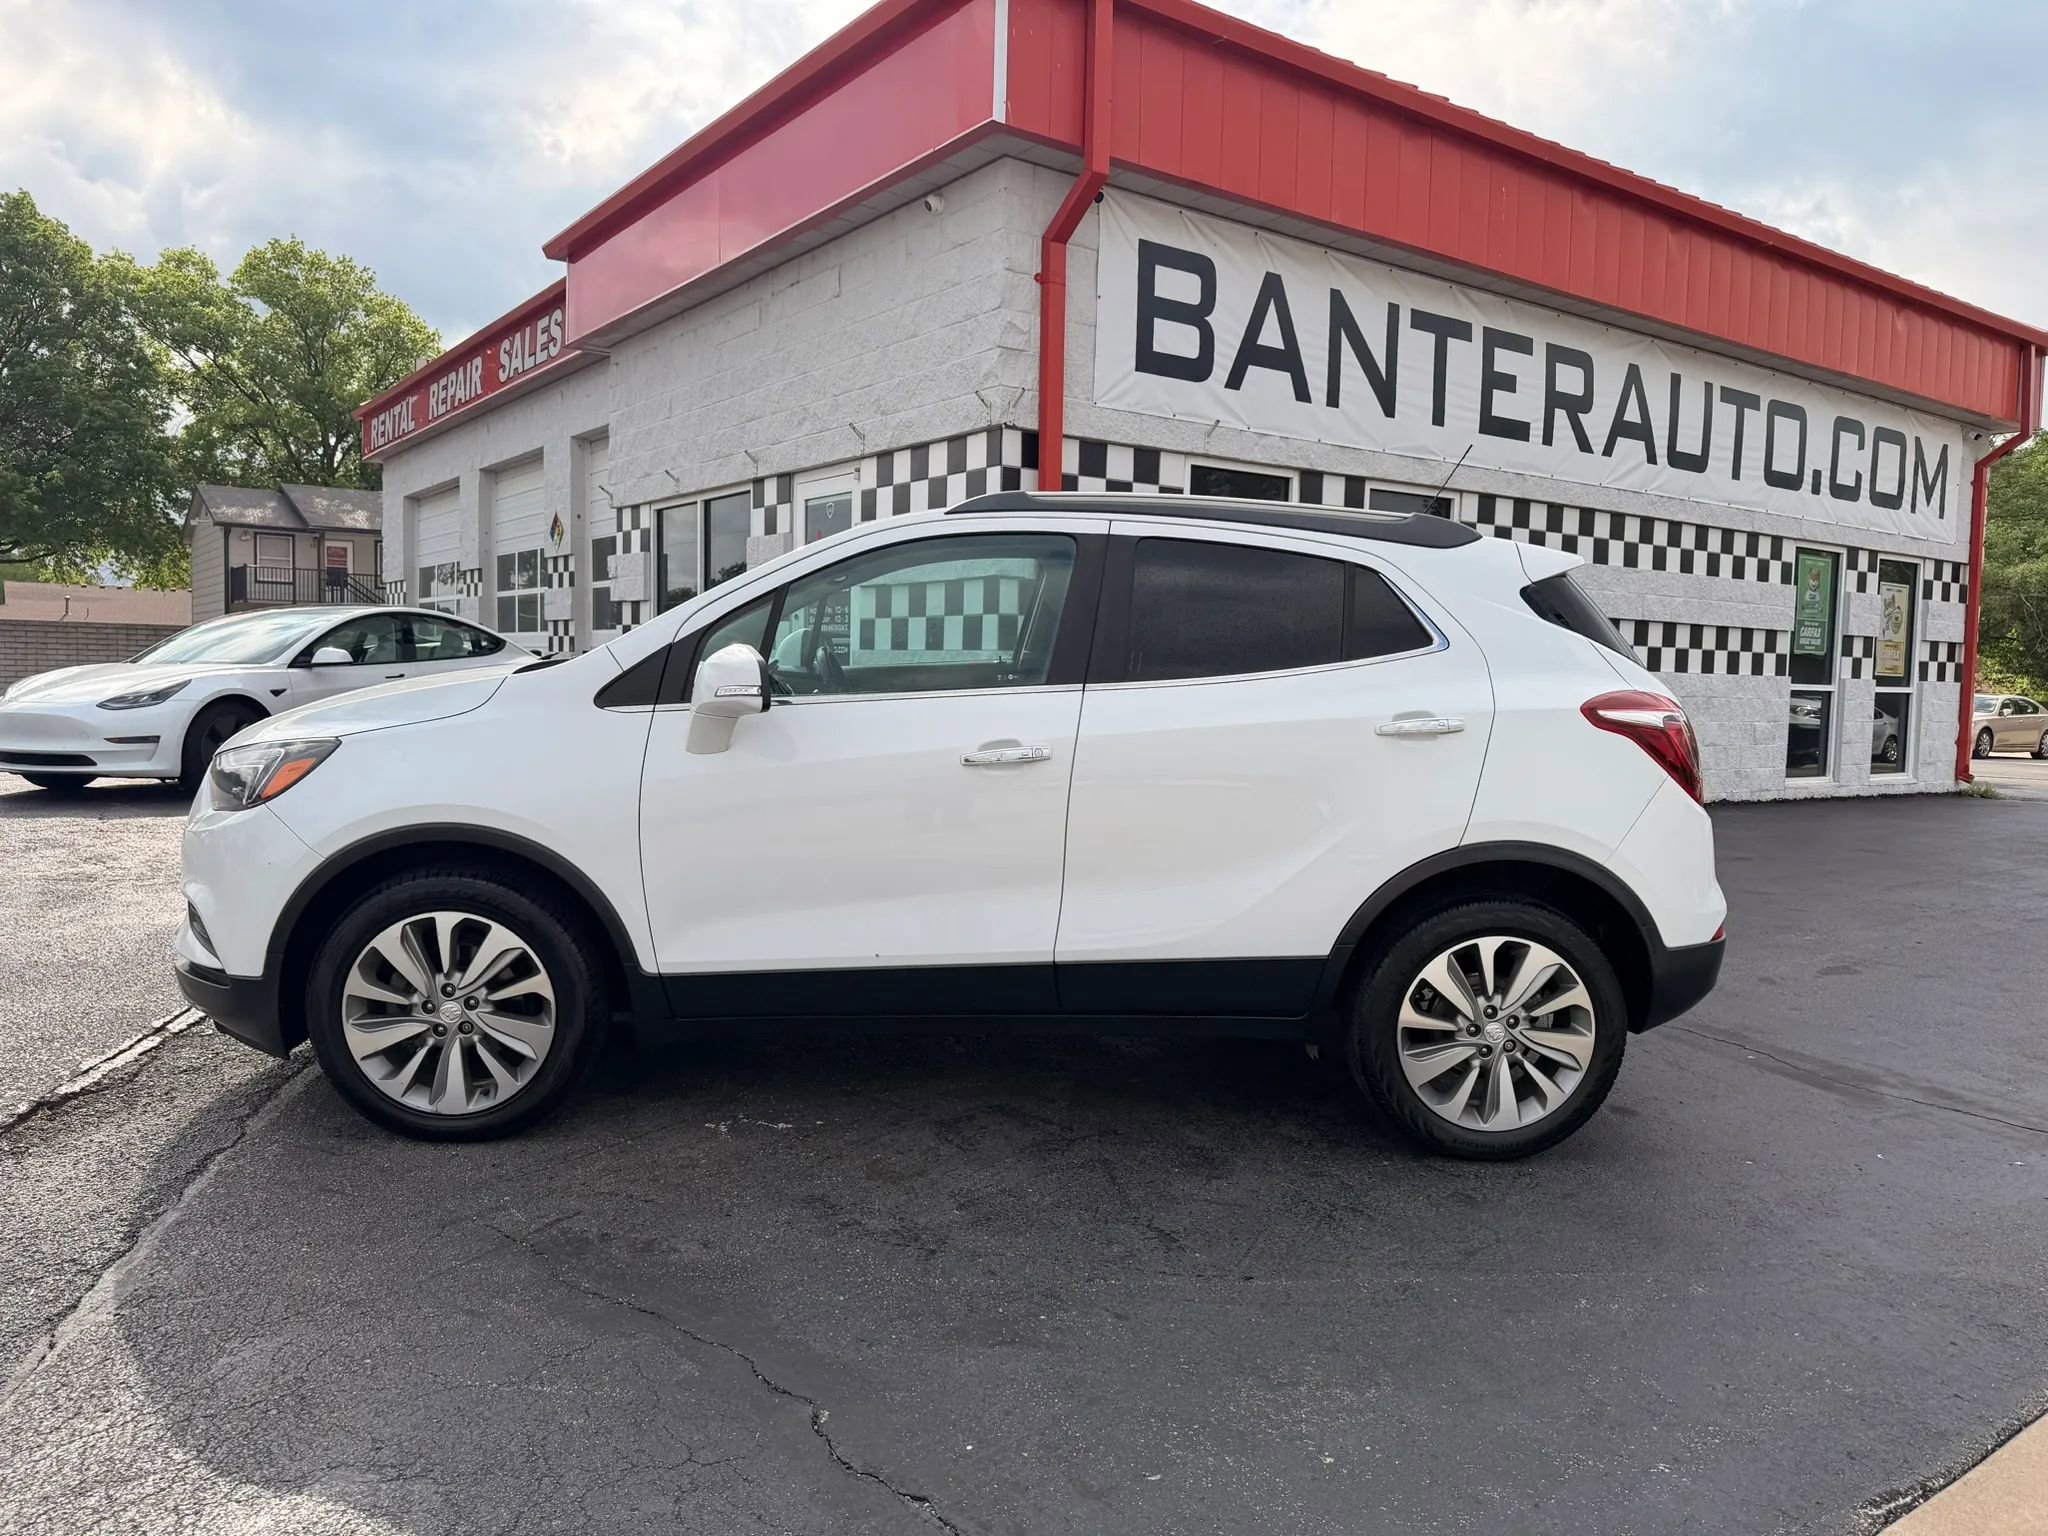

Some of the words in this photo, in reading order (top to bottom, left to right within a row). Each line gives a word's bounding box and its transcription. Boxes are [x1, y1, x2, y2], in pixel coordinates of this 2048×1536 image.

[371, 398, 416, 451] RENTAL
[428, 356, 483, 422] REPAIR
[498, 308, 563, 384] SALES
[1134, 238, 1952, 520] BANTERAUTO.COM
